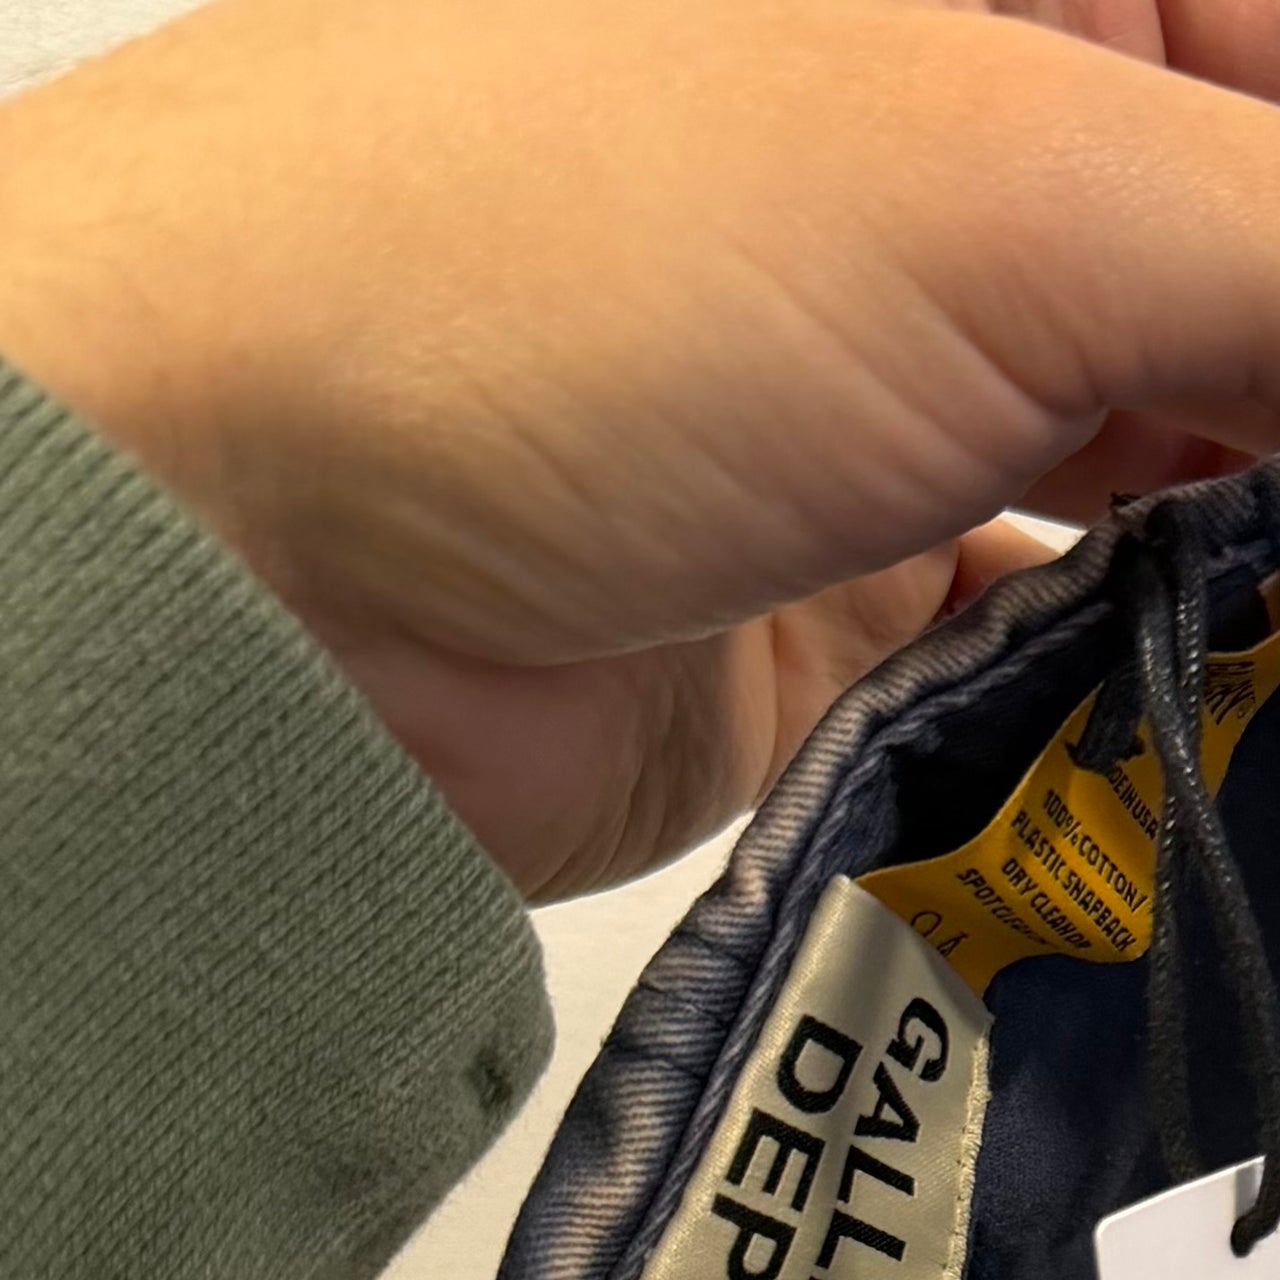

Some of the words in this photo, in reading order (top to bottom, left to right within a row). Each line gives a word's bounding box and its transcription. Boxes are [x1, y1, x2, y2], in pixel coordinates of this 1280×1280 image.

[955, 866, 1005, 906] SPOT
[1000, 856, 1038, 896] DRY
[1009, 809, 1066, 882] PLASTIC
[1062, 872, 1137, 953] SNAPBACK
